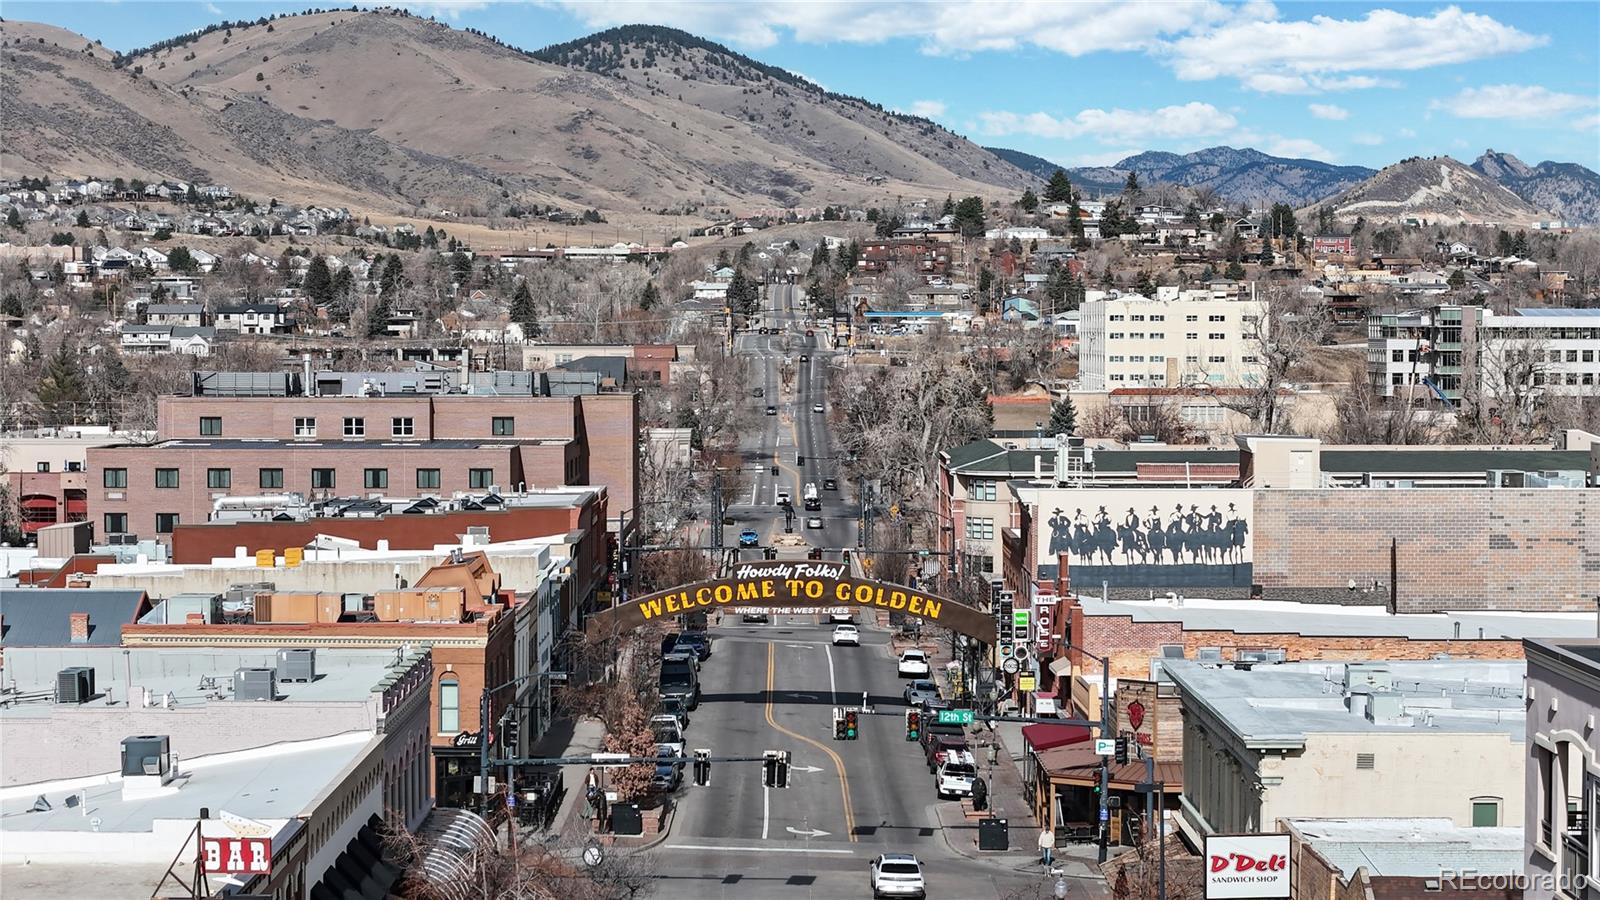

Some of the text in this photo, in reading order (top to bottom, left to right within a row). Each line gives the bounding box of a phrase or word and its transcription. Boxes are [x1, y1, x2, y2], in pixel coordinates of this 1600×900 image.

[737, 564, 845, 580] Howdy Folks!
[639, 580, 942, 619] WELCOME TO GOLDEN
[941, 711, 972, 722] 12th St
[456, 734, 478, 746] Grill
[205, 841, 269, 871] BAR
[1210, 853, 1286, 872] D'Deli
